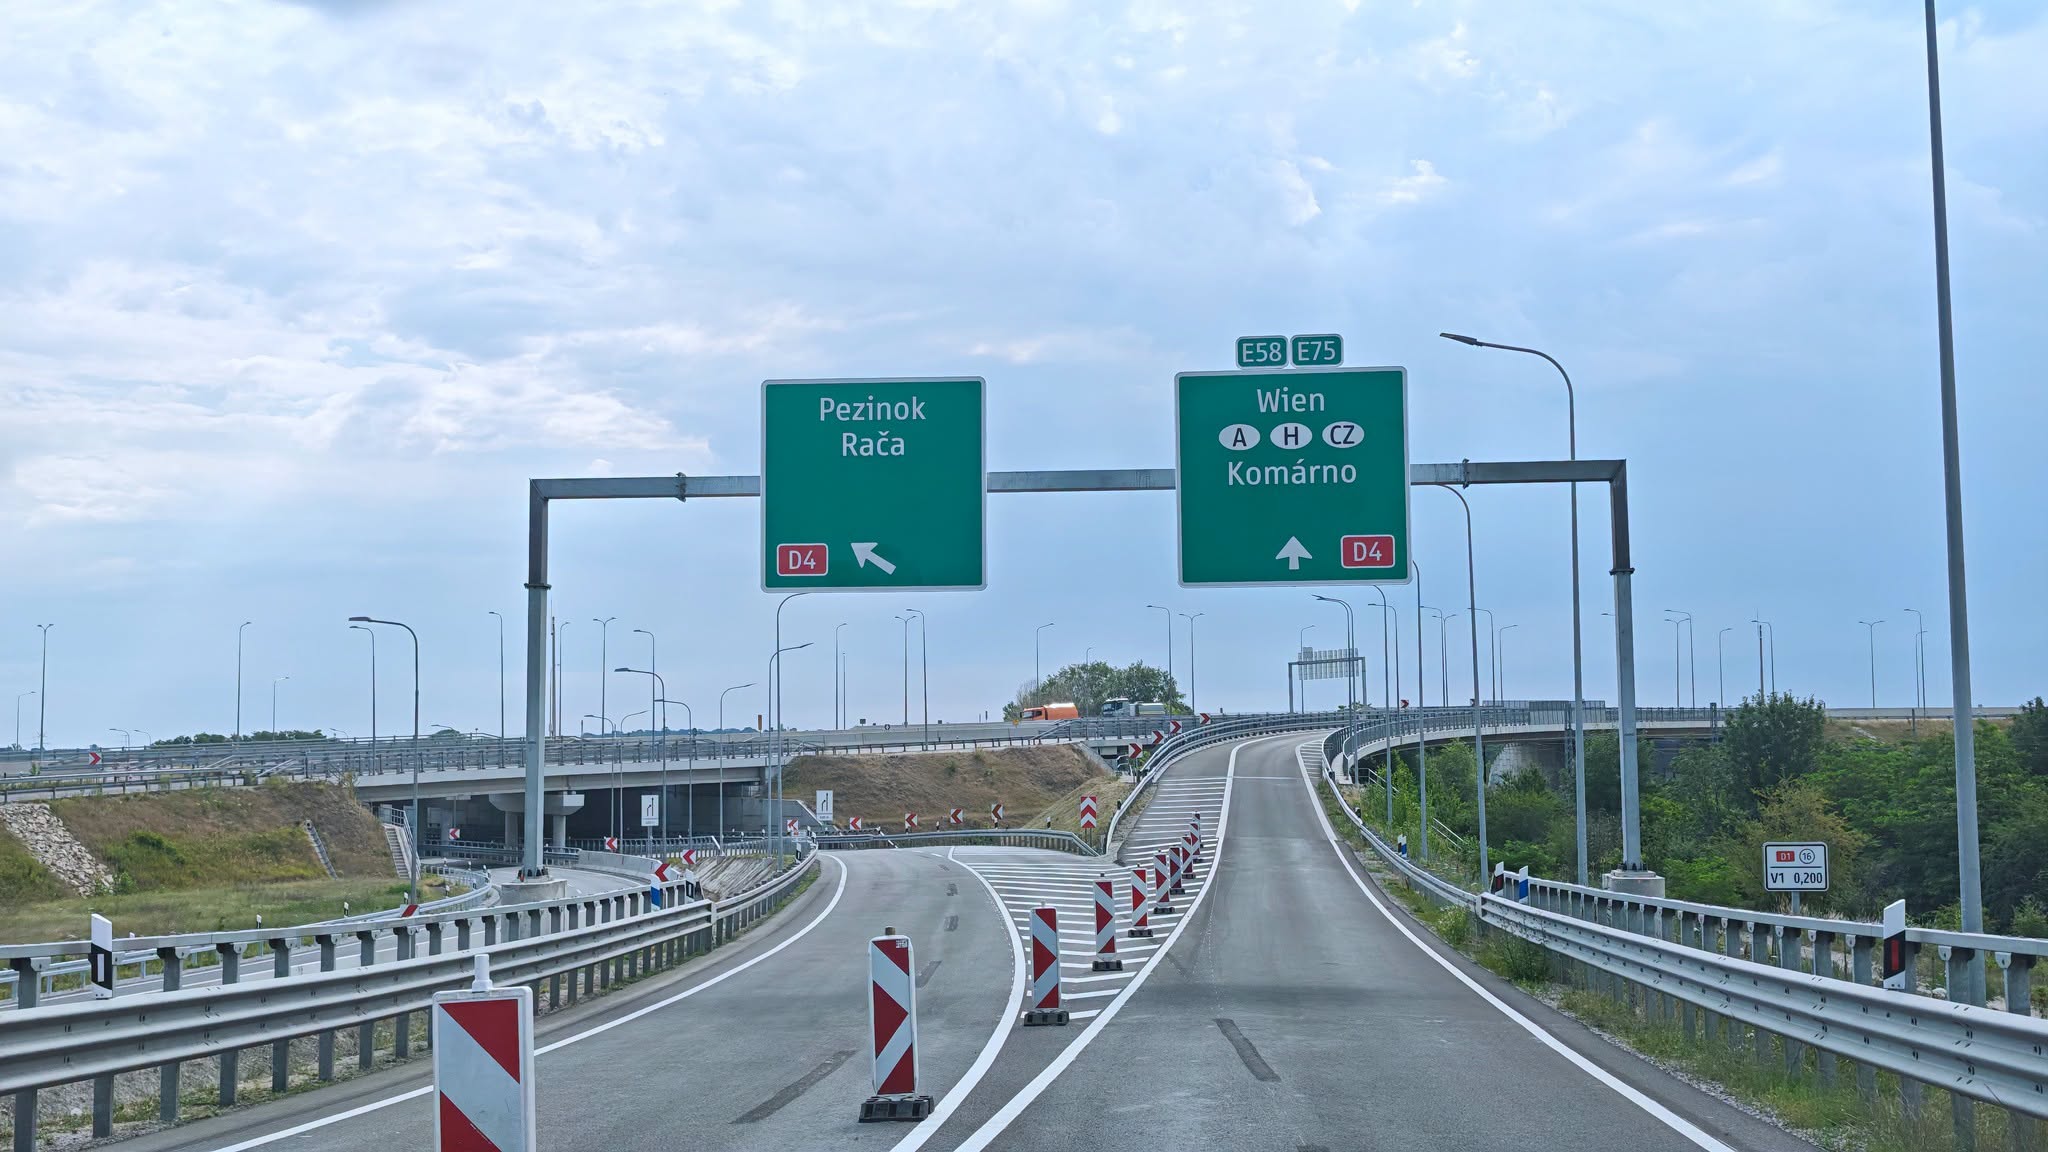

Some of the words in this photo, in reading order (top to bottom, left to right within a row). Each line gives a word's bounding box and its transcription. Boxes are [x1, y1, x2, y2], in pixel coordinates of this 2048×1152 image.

[1242, 342, 1282, 363] E58
[1297, 340, 1336, 361] E75
[820, 395, 926, 421] Pezinok
[1256, 386, 1325, 413] Wien
[842, 430, 905, 456] Rača
[1232, 427, 1247, 447] A
[1283, 426, 1299, 446] H
[1330, 425, 1355, 445] CZ
[1228, 458, 1357, 486] Komárno
[788, 550, 816, 570] D4
[1353, 541, 1382, 562] D4
[1780, 852, 1791, 861] D1
[1802, 852, 1812, 861] 16
[1770, 872, 1785, 884] V1
[1793, 872, 1823, 885] 0,200
